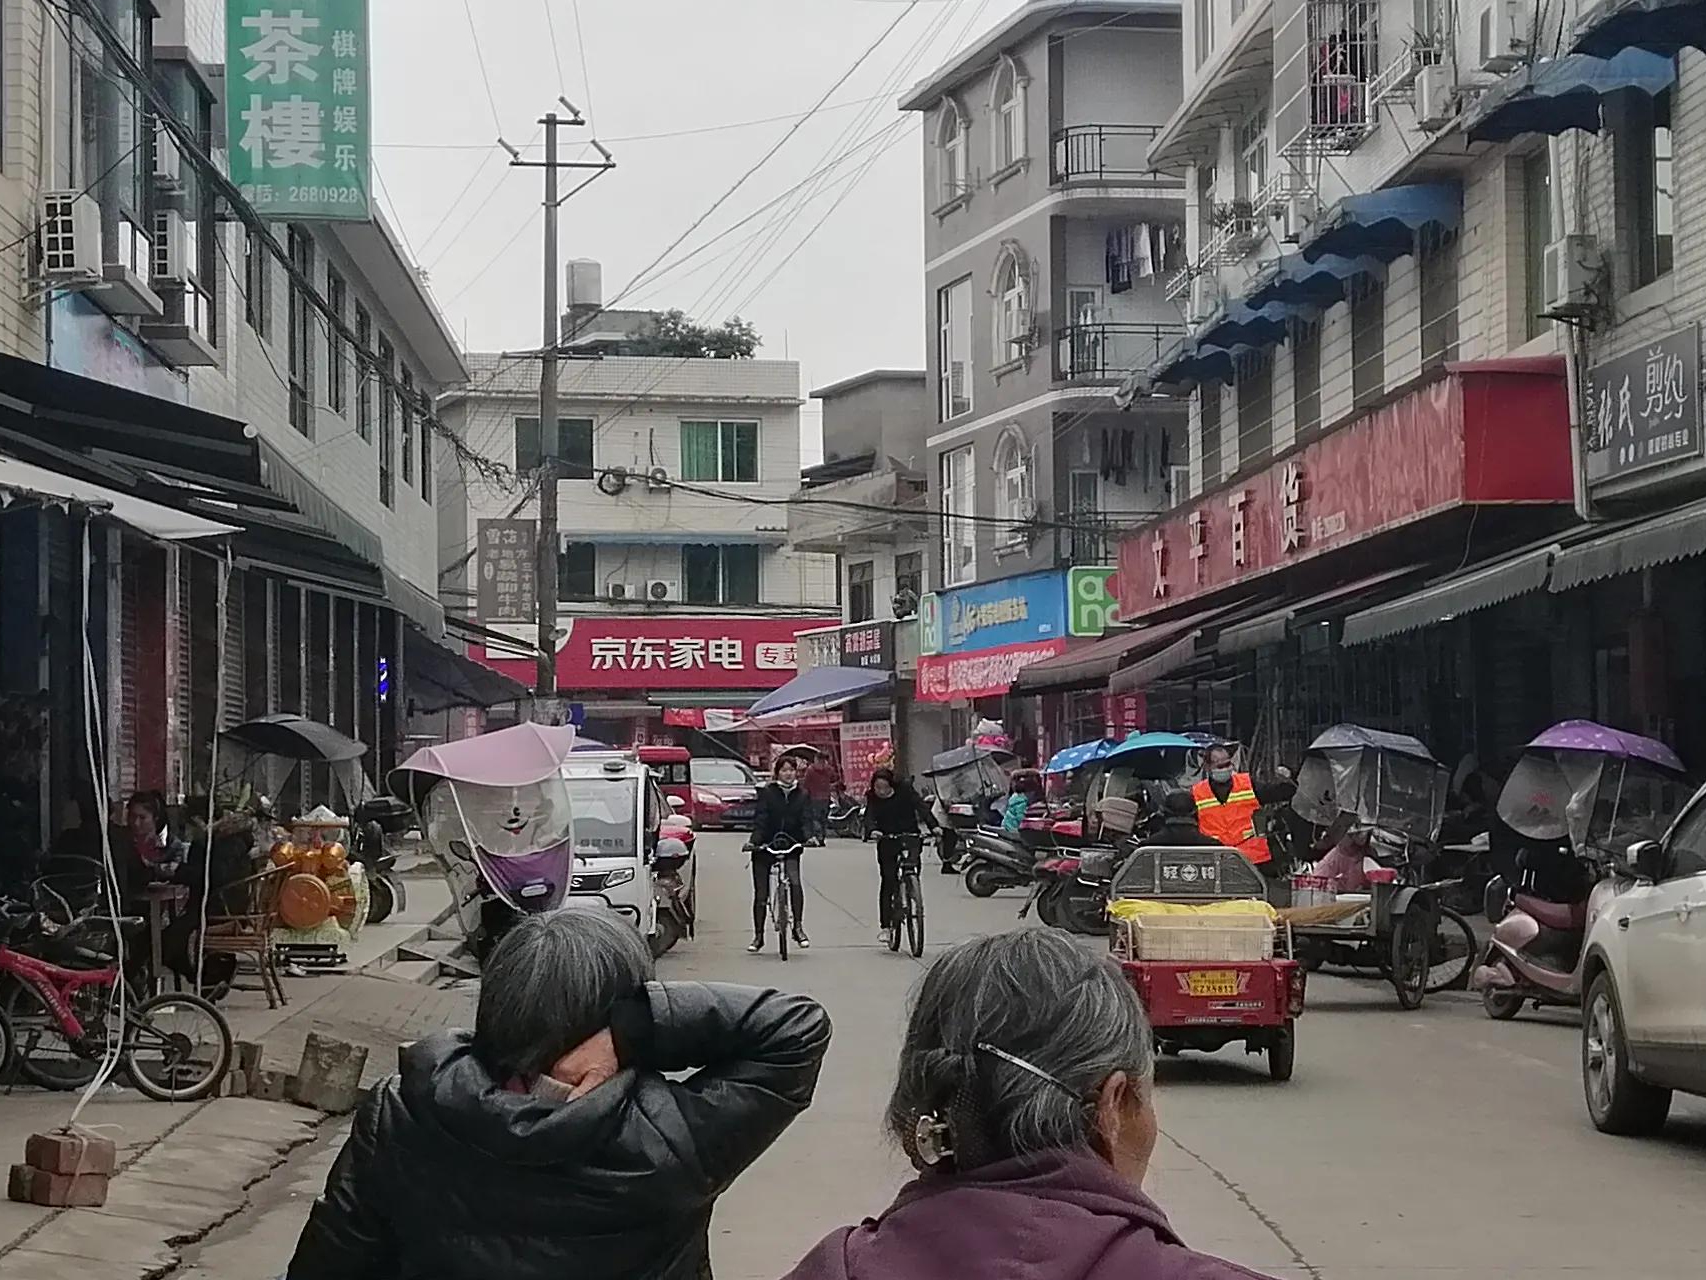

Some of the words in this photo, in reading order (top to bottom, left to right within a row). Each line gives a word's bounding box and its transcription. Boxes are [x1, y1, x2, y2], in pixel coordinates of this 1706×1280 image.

[331, 29, 359, 173] 棋牌娱乐
[590, 635, 745, 670] 京东家电
